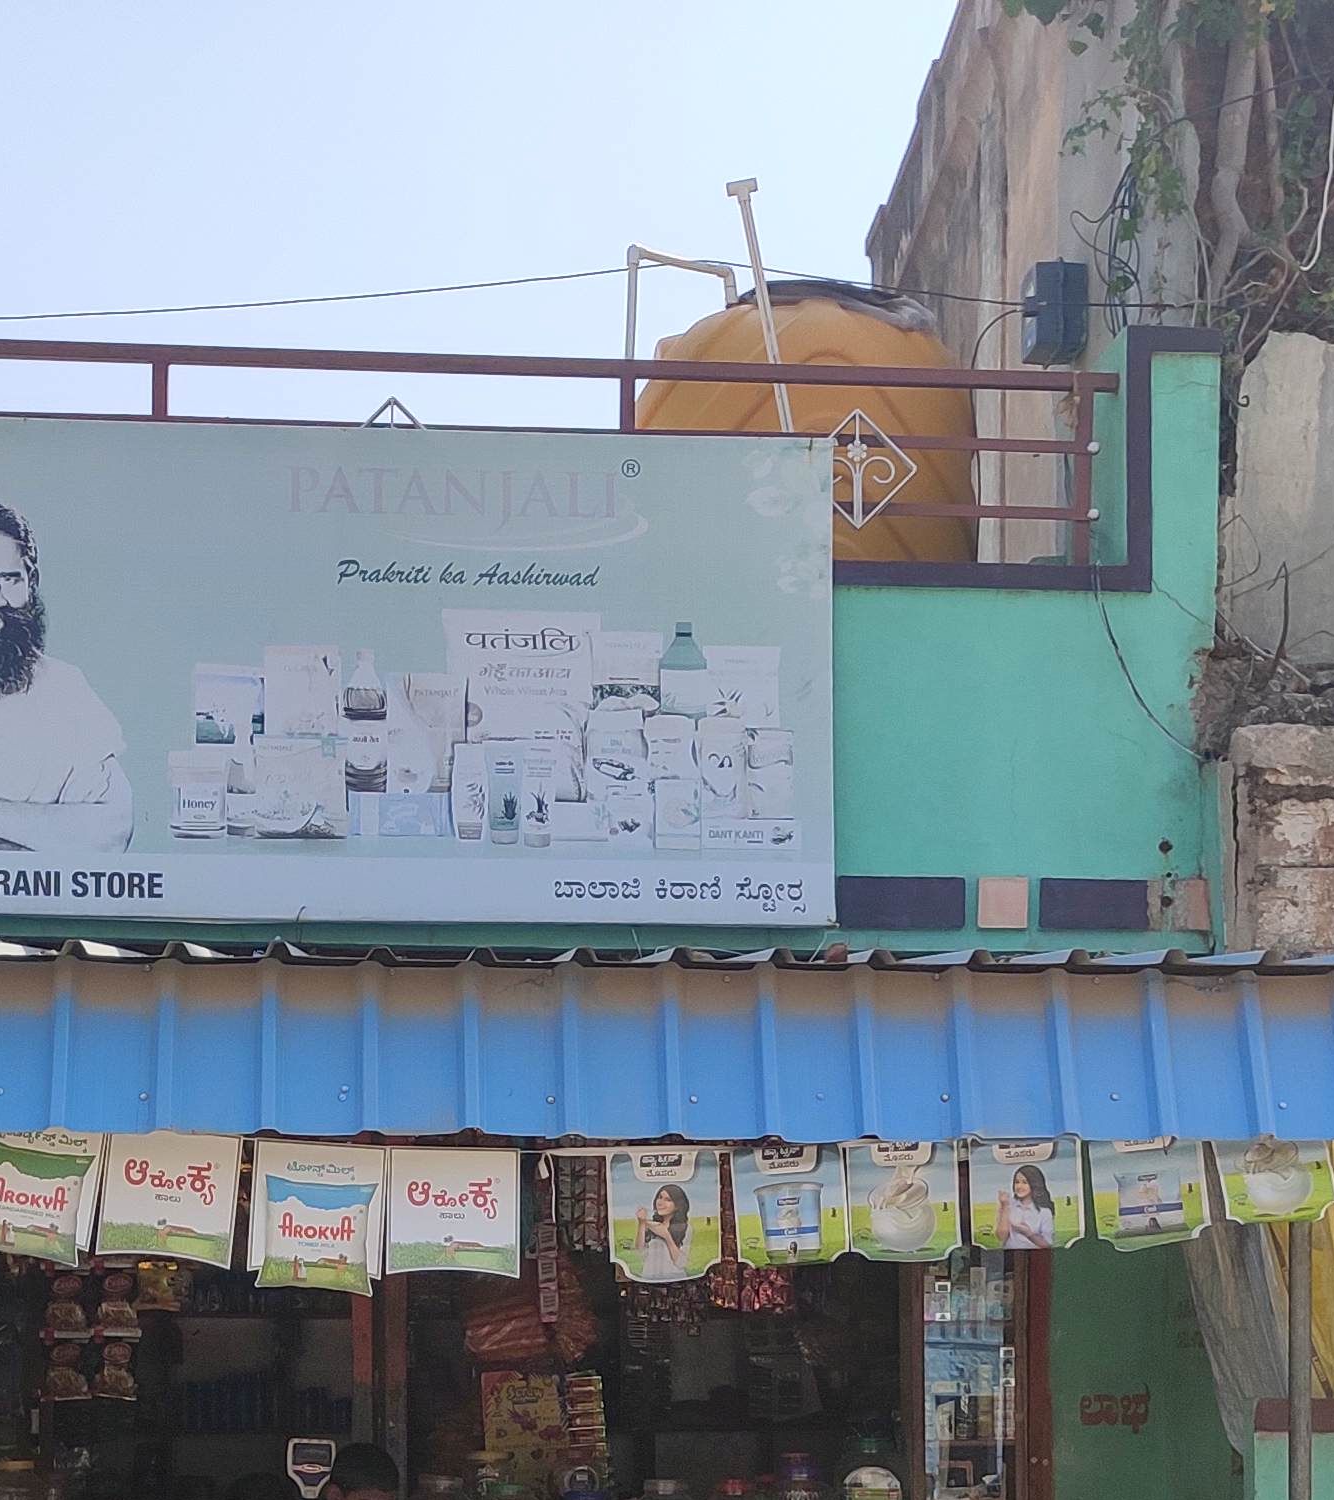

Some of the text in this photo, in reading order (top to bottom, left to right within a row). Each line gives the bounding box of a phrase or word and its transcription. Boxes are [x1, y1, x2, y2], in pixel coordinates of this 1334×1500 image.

[287, 463, 620, 531] PATANJALI
[336, 558, 601, 588] Prakriti ka Aashirwad
[464, 627, 579, 655] पतंजलि
[182, 798, 217, 811] Honey
[71, 871, 164, 899] STORE
[554, 878, 641, 899] ಬಾಲಾಜಿ
[655, 876, 722, 900] ಕಿರಾಣಿ
[124, 1158, 216, 1205] ಆರೋಕ್ಯ
[407, 1177, 499, 1220] ಆರೋಕ್ಯ
[278, 1212, 356, 1242] AROKYA
